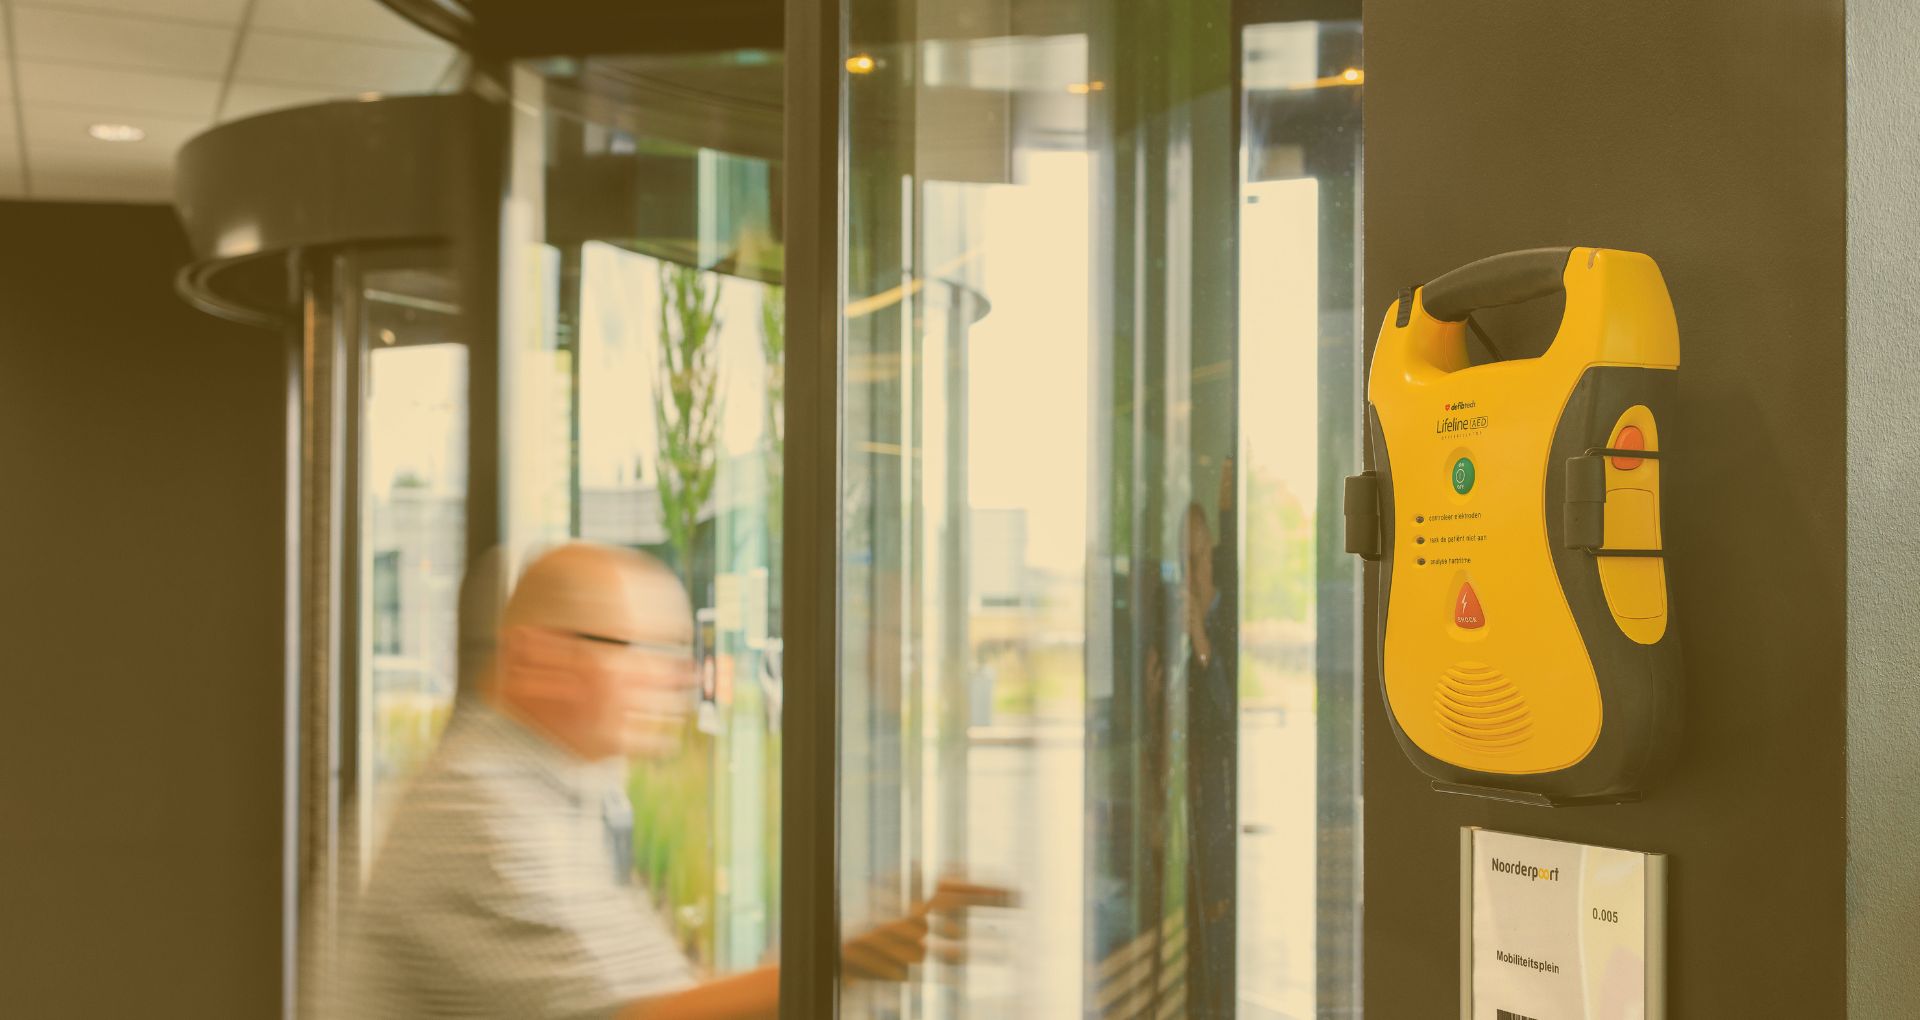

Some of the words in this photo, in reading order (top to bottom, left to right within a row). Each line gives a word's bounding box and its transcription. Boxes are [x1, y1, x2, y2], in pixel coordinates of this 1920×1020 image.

[1436, 417, 1469, 434] Lifeline
[1471, 417, 1487, 428] AED
[1491, 857, 1559, 882] Noorderpoort
[1592, 907, 1619, 924] 0.005
[1496, 950, 1560, 975] Mobiliteitsplein
